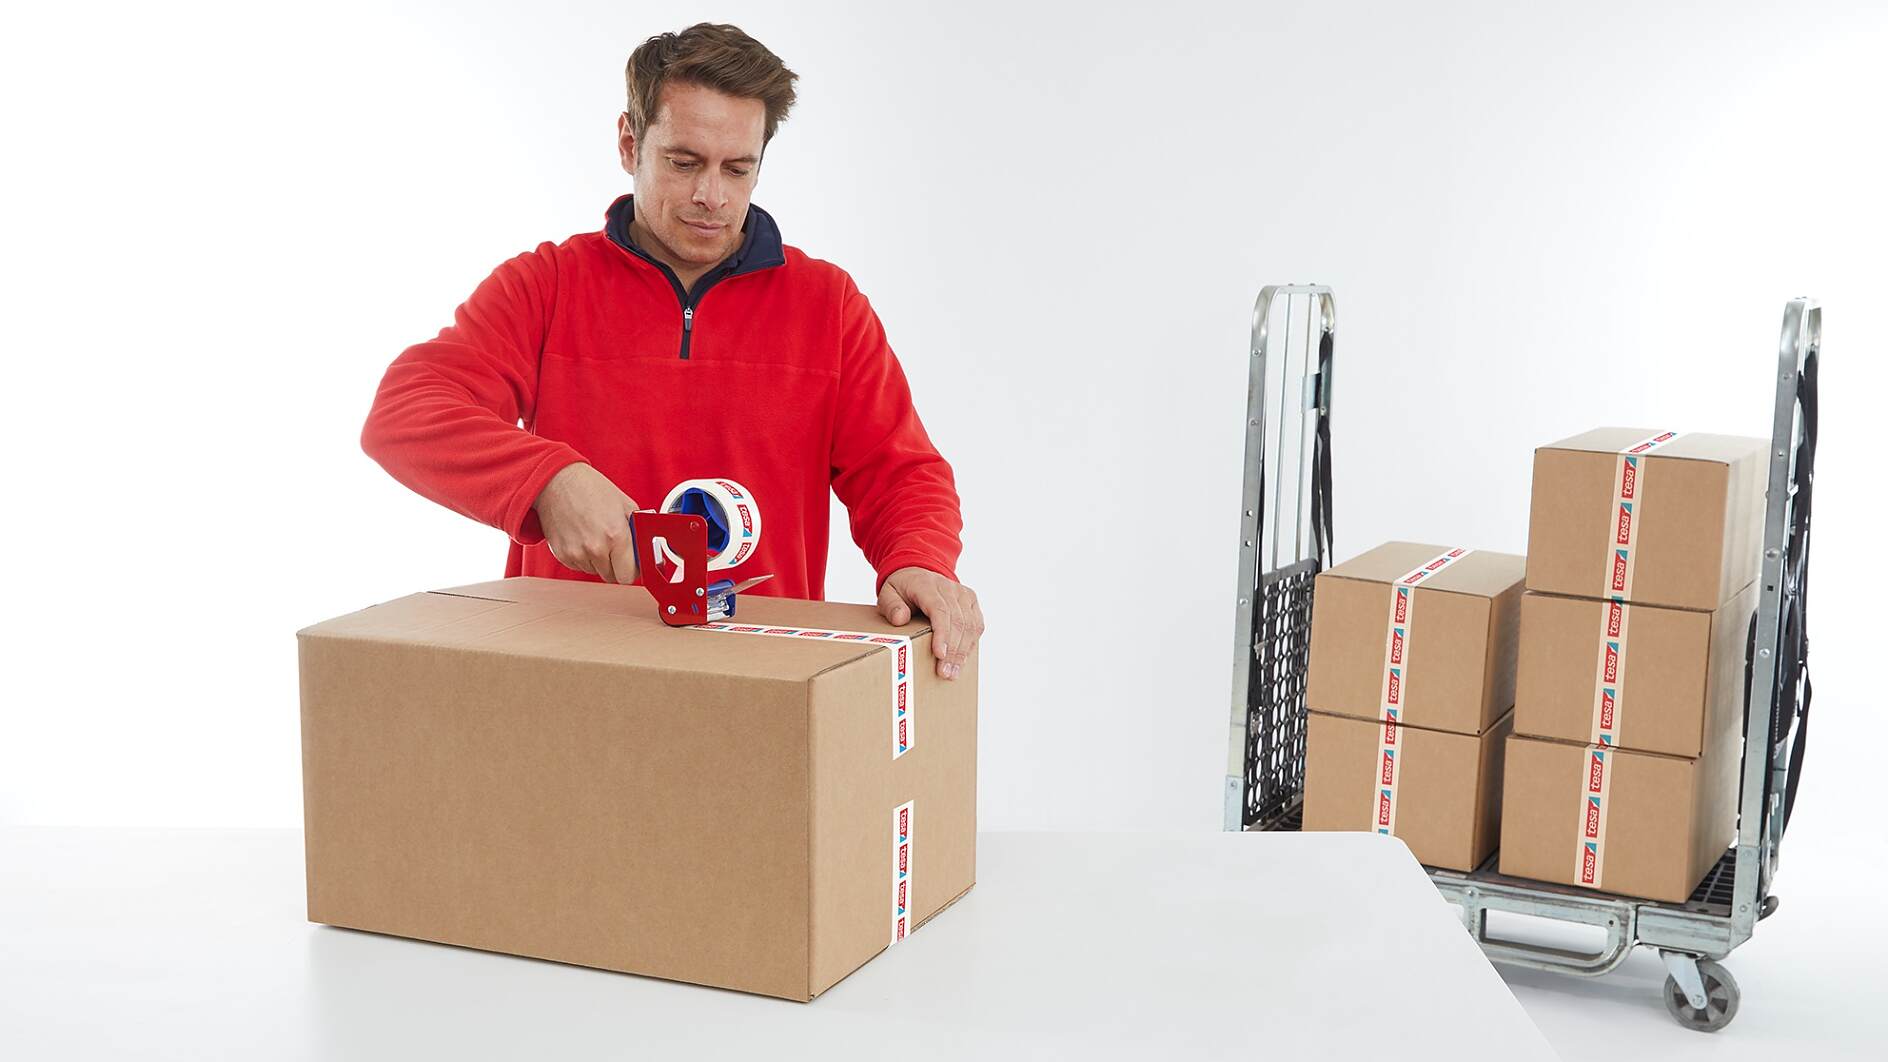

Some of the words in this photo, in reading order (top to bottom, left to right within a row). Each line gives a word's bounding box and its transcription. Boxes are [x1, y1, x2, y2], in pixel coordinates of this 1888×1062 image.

[1623, 469, 1635, 496] tesa
[740, 506, 751, 527] tesa
[1618, 514, 1631, 542] tesa
[1613, 561, 1626, 589] tesa
[1396, 598, 1407, 622] tesa
[1608, 608, 1621, 635] tesa
[1392, 638, 1403, 662] tesa
[1605, 654, 1617, 680] tesa
[1389, 679, 1399, 702] tesa
[1601, 700, 1613, 727] tesa
[1383, 760, 1393, 782] tesa
[1589, 763, 1602, 790] tesa
[1380, 800, 1390, 822] tesa
[1586, 809, 1598, 835] tesa
[1583, 854, 1595, 881] tesa
